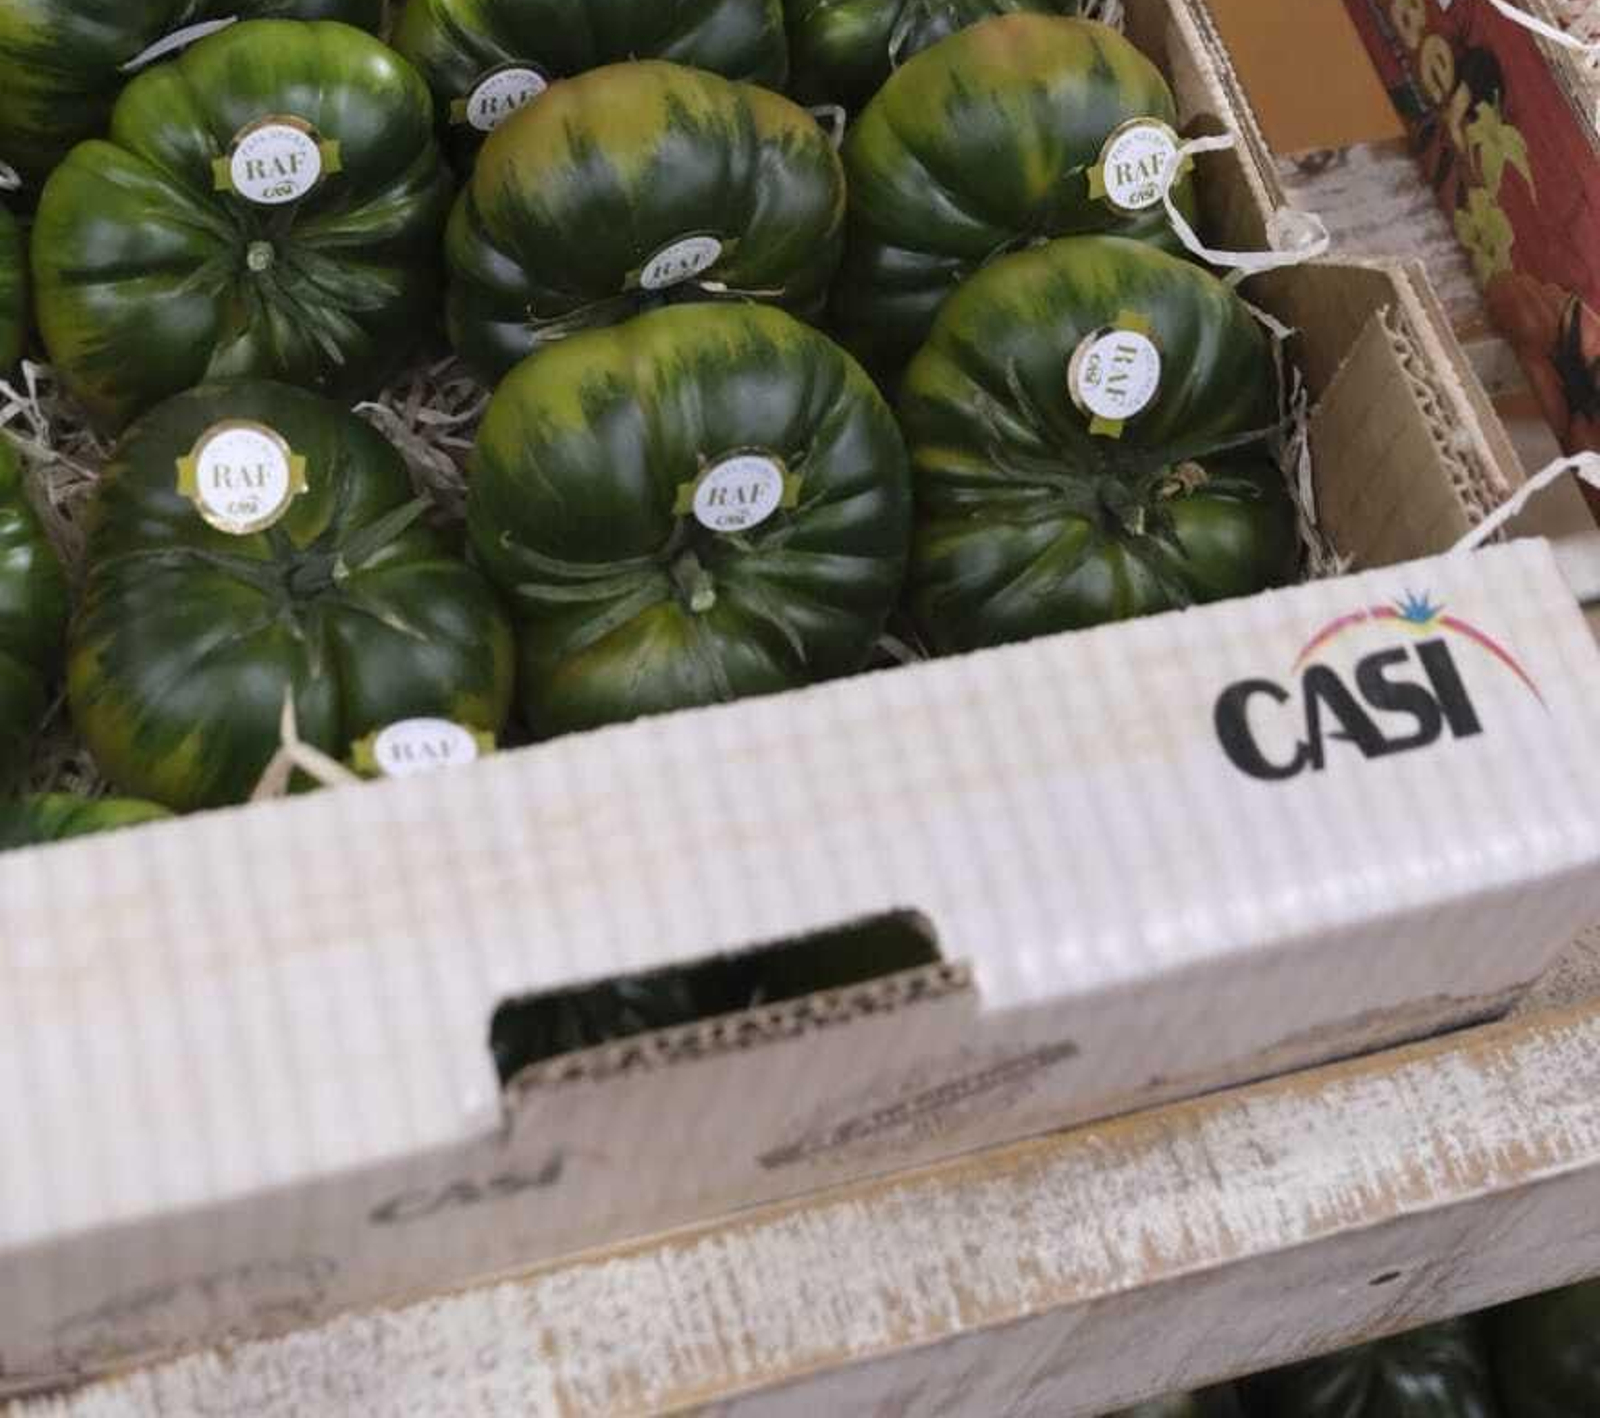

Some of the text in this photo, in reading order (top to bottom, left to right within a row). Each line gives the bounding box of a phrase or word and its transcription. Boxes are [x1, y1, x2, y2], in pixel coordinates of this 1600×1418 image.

[244, 151, 308, 182] RAF
[1113, 150, 1167, 186] RAF
[1104, 343, 1138, 404] RAF
[211, 463, 272, 489] RAF
[707, 482, 766, 508] RAF
[1213, 638, 1483, 781] CASI
[390, 738, 459, 763] RAF
